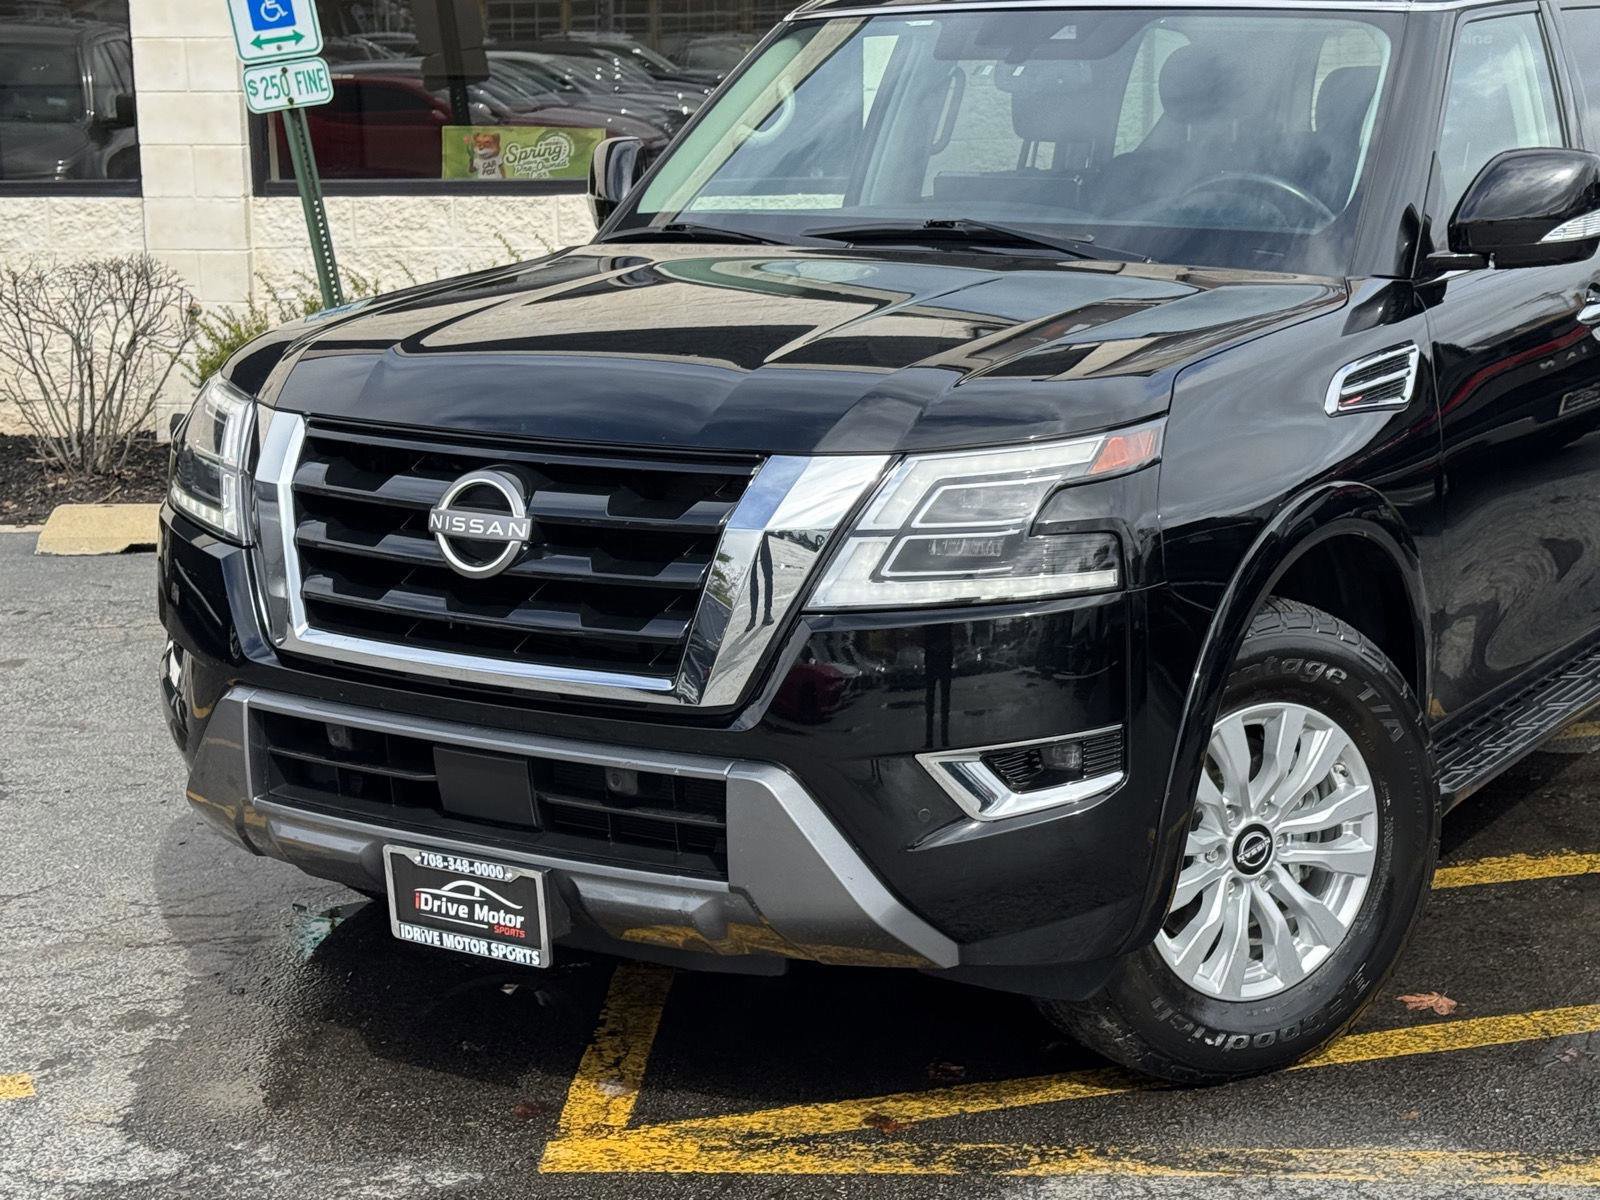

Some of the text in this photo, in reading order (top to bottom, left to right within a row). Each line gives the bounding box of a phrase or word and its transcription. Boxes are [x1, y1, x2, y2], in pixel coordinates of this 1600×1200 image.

[294, 68, 328, 95] FINE
[482, 160, 496, 169] CAR
[506, 142, 563, 164] Spring
[481, 167, 496, 176] FOX
[430, 513, 527, 538] NISSAN
[420, 852, 504, 880] 708-348-0000
[414, 891, 525, 929] iDrive Motor
[493, 925, 527, 938] SPORTS
[443, 934, 489, 957] MOTOR
[490, 944, 541, 966] SPORTS
